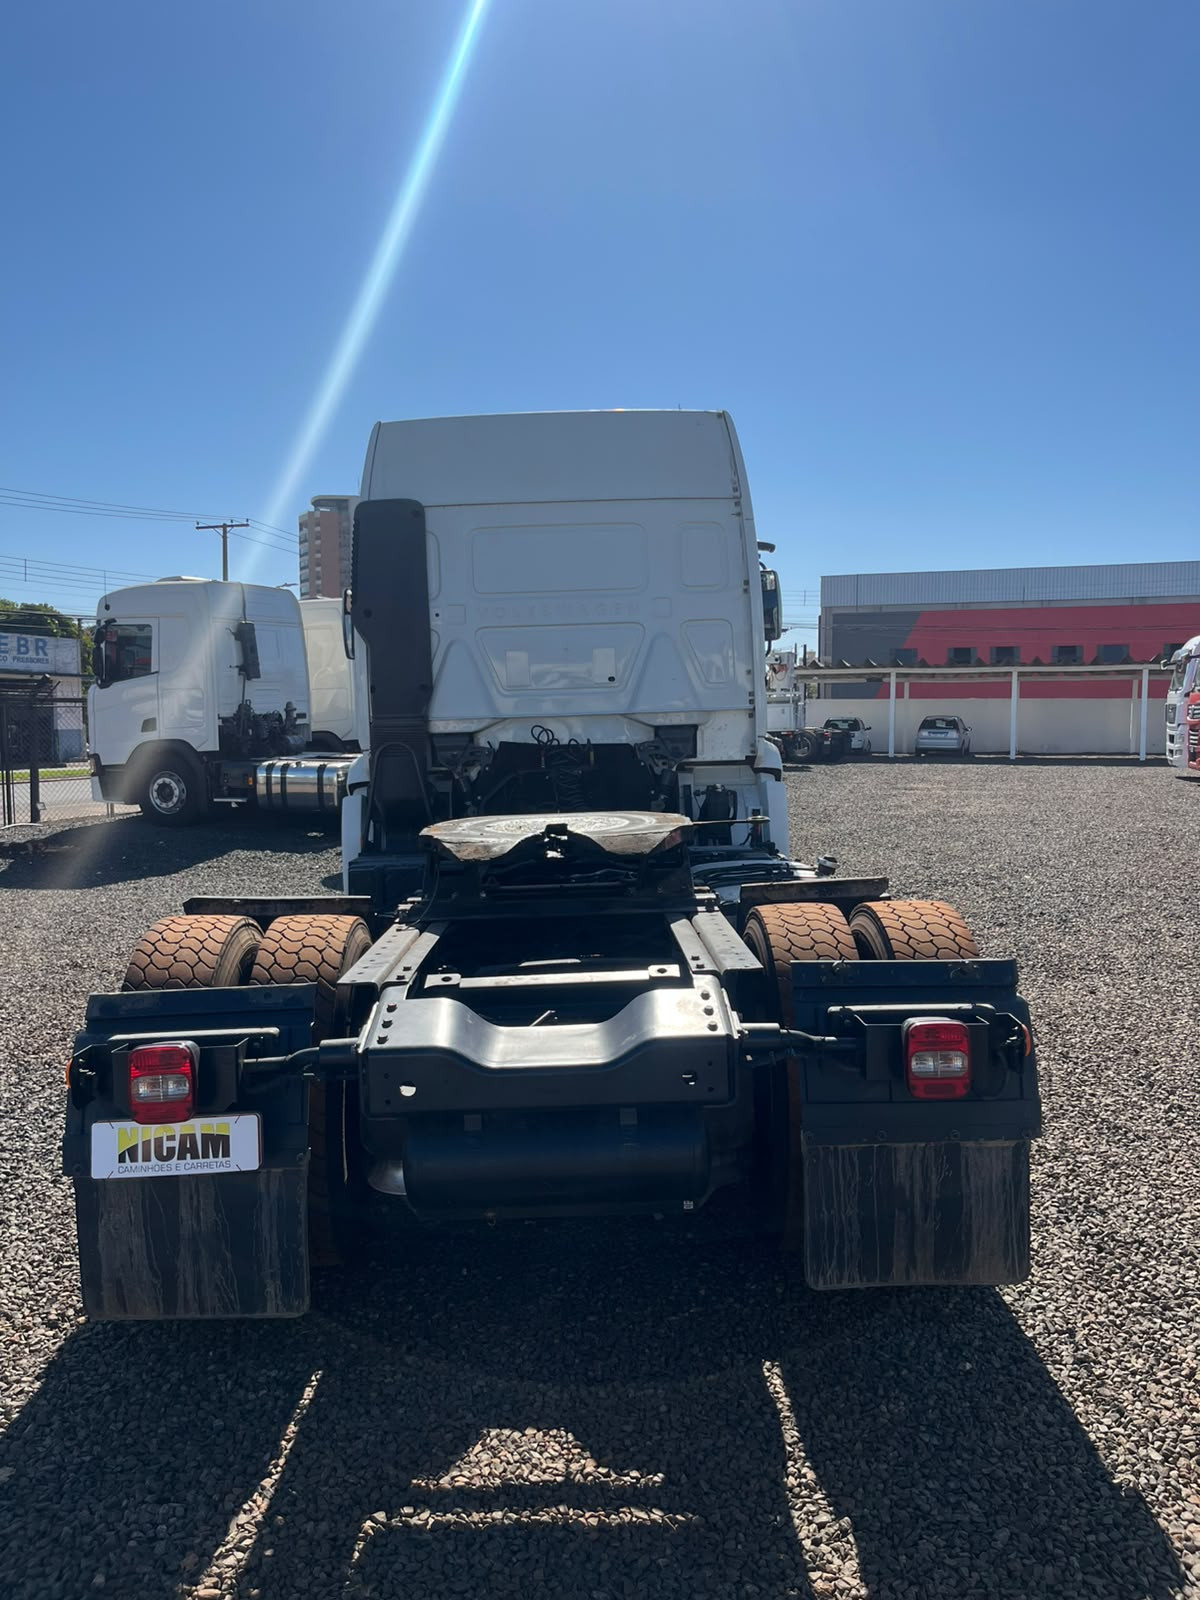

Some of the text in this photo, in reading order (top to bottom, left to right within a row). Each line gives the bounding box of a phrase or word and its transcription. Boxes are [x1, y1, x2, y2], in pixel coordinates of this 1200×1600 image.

[118, 1122, 231, 1163] NICAM
[175, 1163, 182, 1172] E
[184, 1160, 231, 1171] CARRETAS
